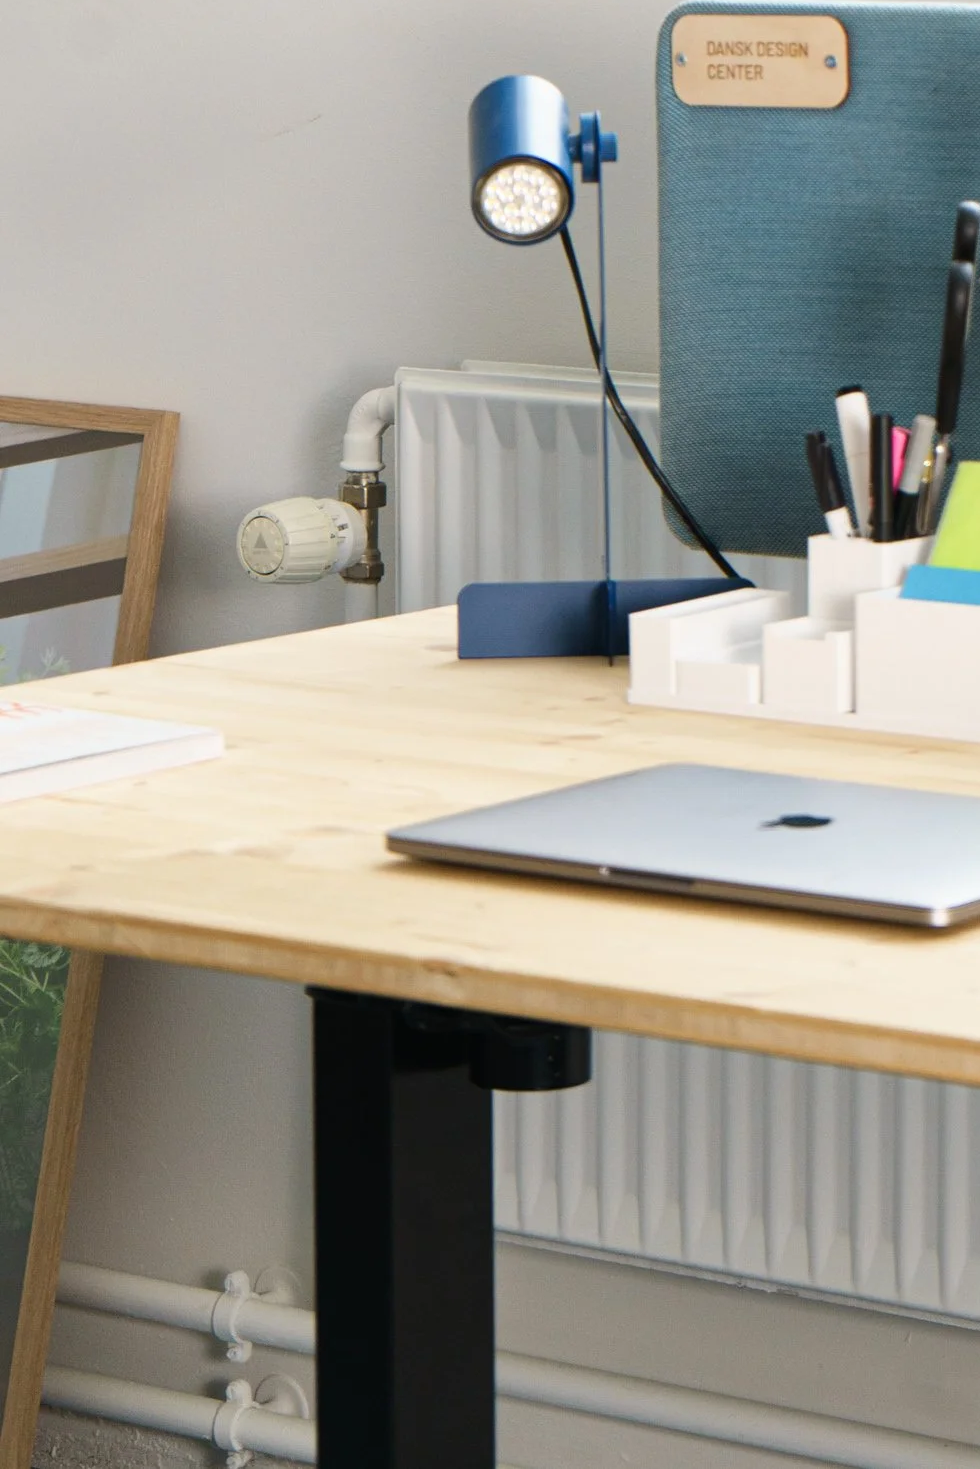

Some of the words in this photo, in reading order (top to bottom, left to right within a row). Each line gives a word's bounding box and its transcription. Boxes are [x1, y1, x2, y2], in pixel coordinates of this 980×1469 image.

[707, 41, 754, 56] DANSK
[757, 41, 809, 57] DESIGN
[707, 64, 764, 80] CENTER
